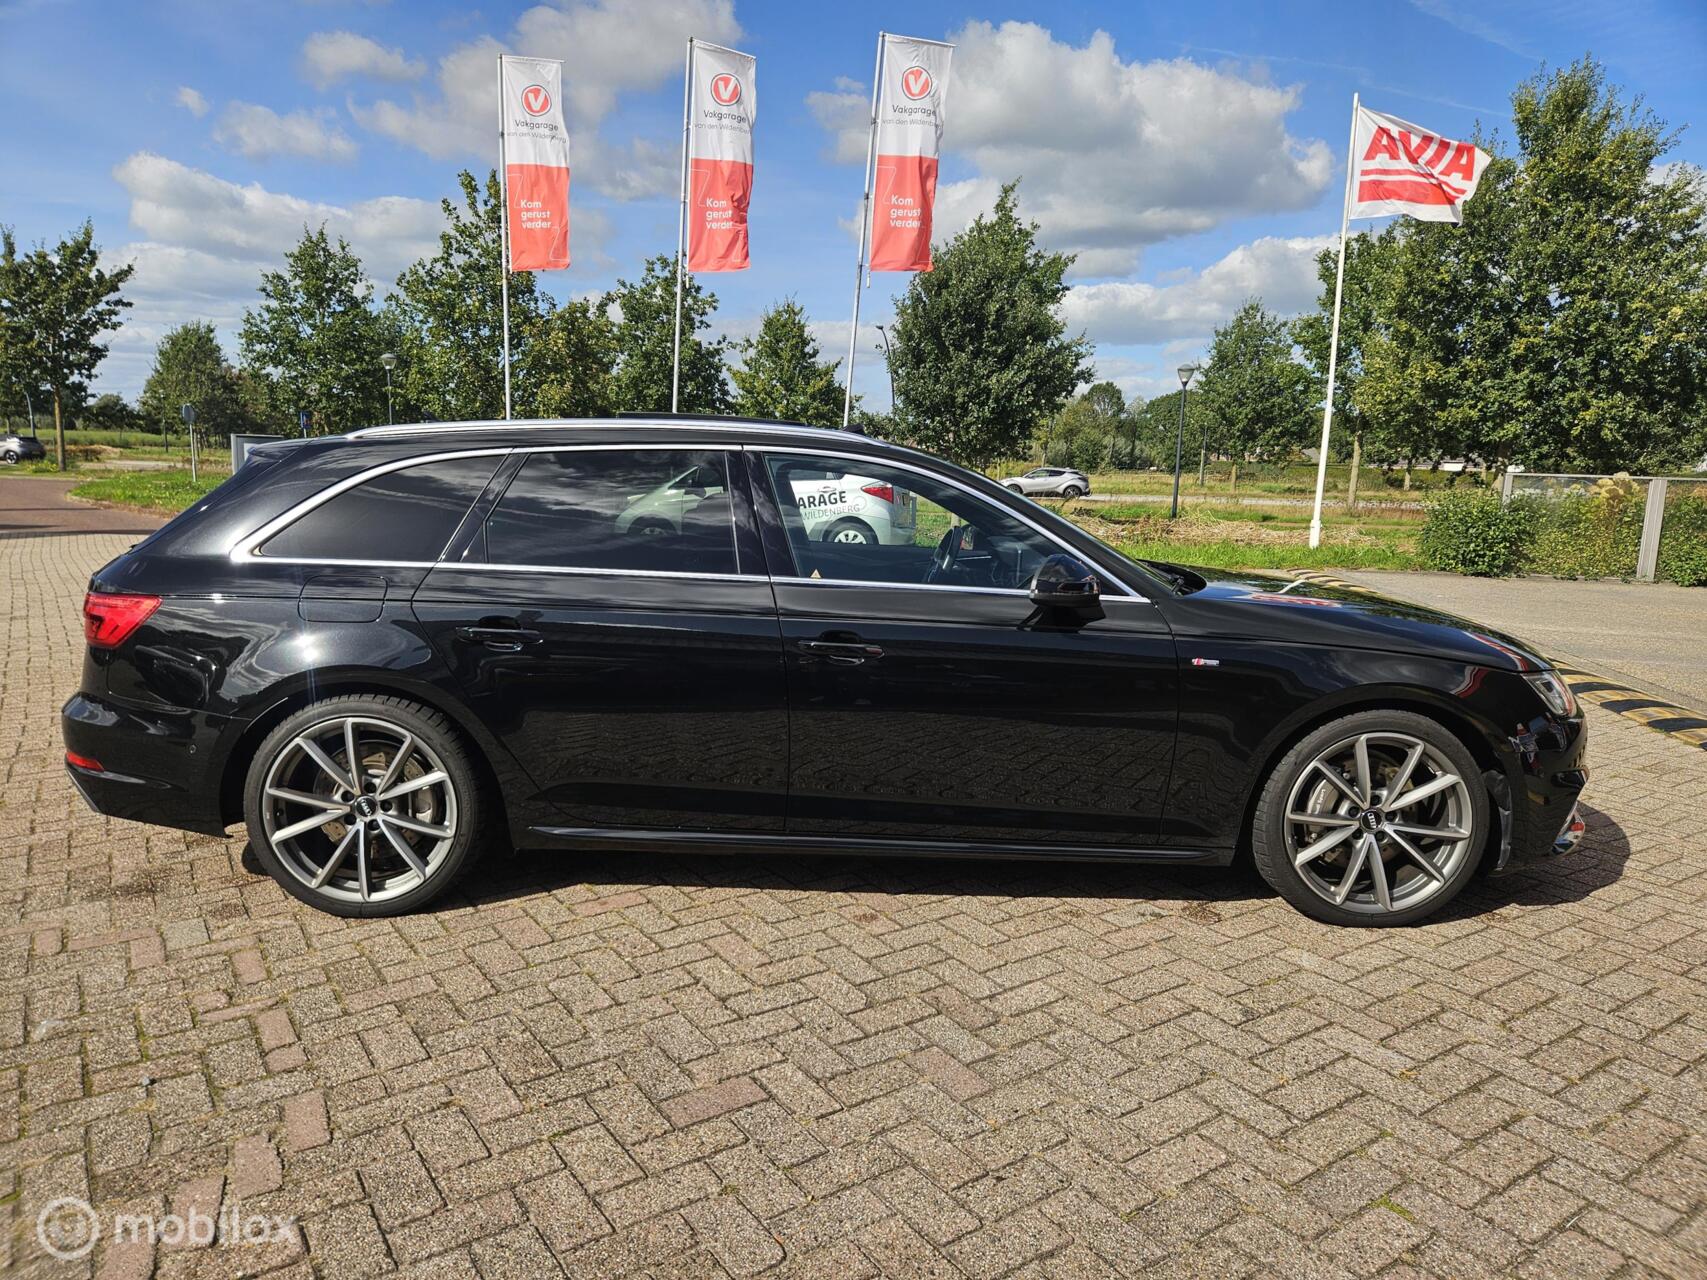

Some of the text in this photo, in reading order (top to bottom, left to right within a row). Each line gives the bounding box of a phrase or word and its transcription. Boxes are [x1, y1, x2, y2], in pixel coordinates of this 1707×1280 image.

[703, 109, 747, 124] Vakgarage
[892, 104, 937, 118] Vakgarage
[514, 119, 559, 132] Vakgarage
[1362, 125, 1476, 182] AVIA
[520, 199, 542, 208] Kom
[706, 197, 727, 208] Kom
[891, 195, 914, 206] Kom
[521, 210, 551, 221] gerust
[890, 207, 922, 219] gerust
[521, 219, 552, 230] verder
[889, 218, 922, 229] verder
[798, 490, 848, 510] ARAGE
